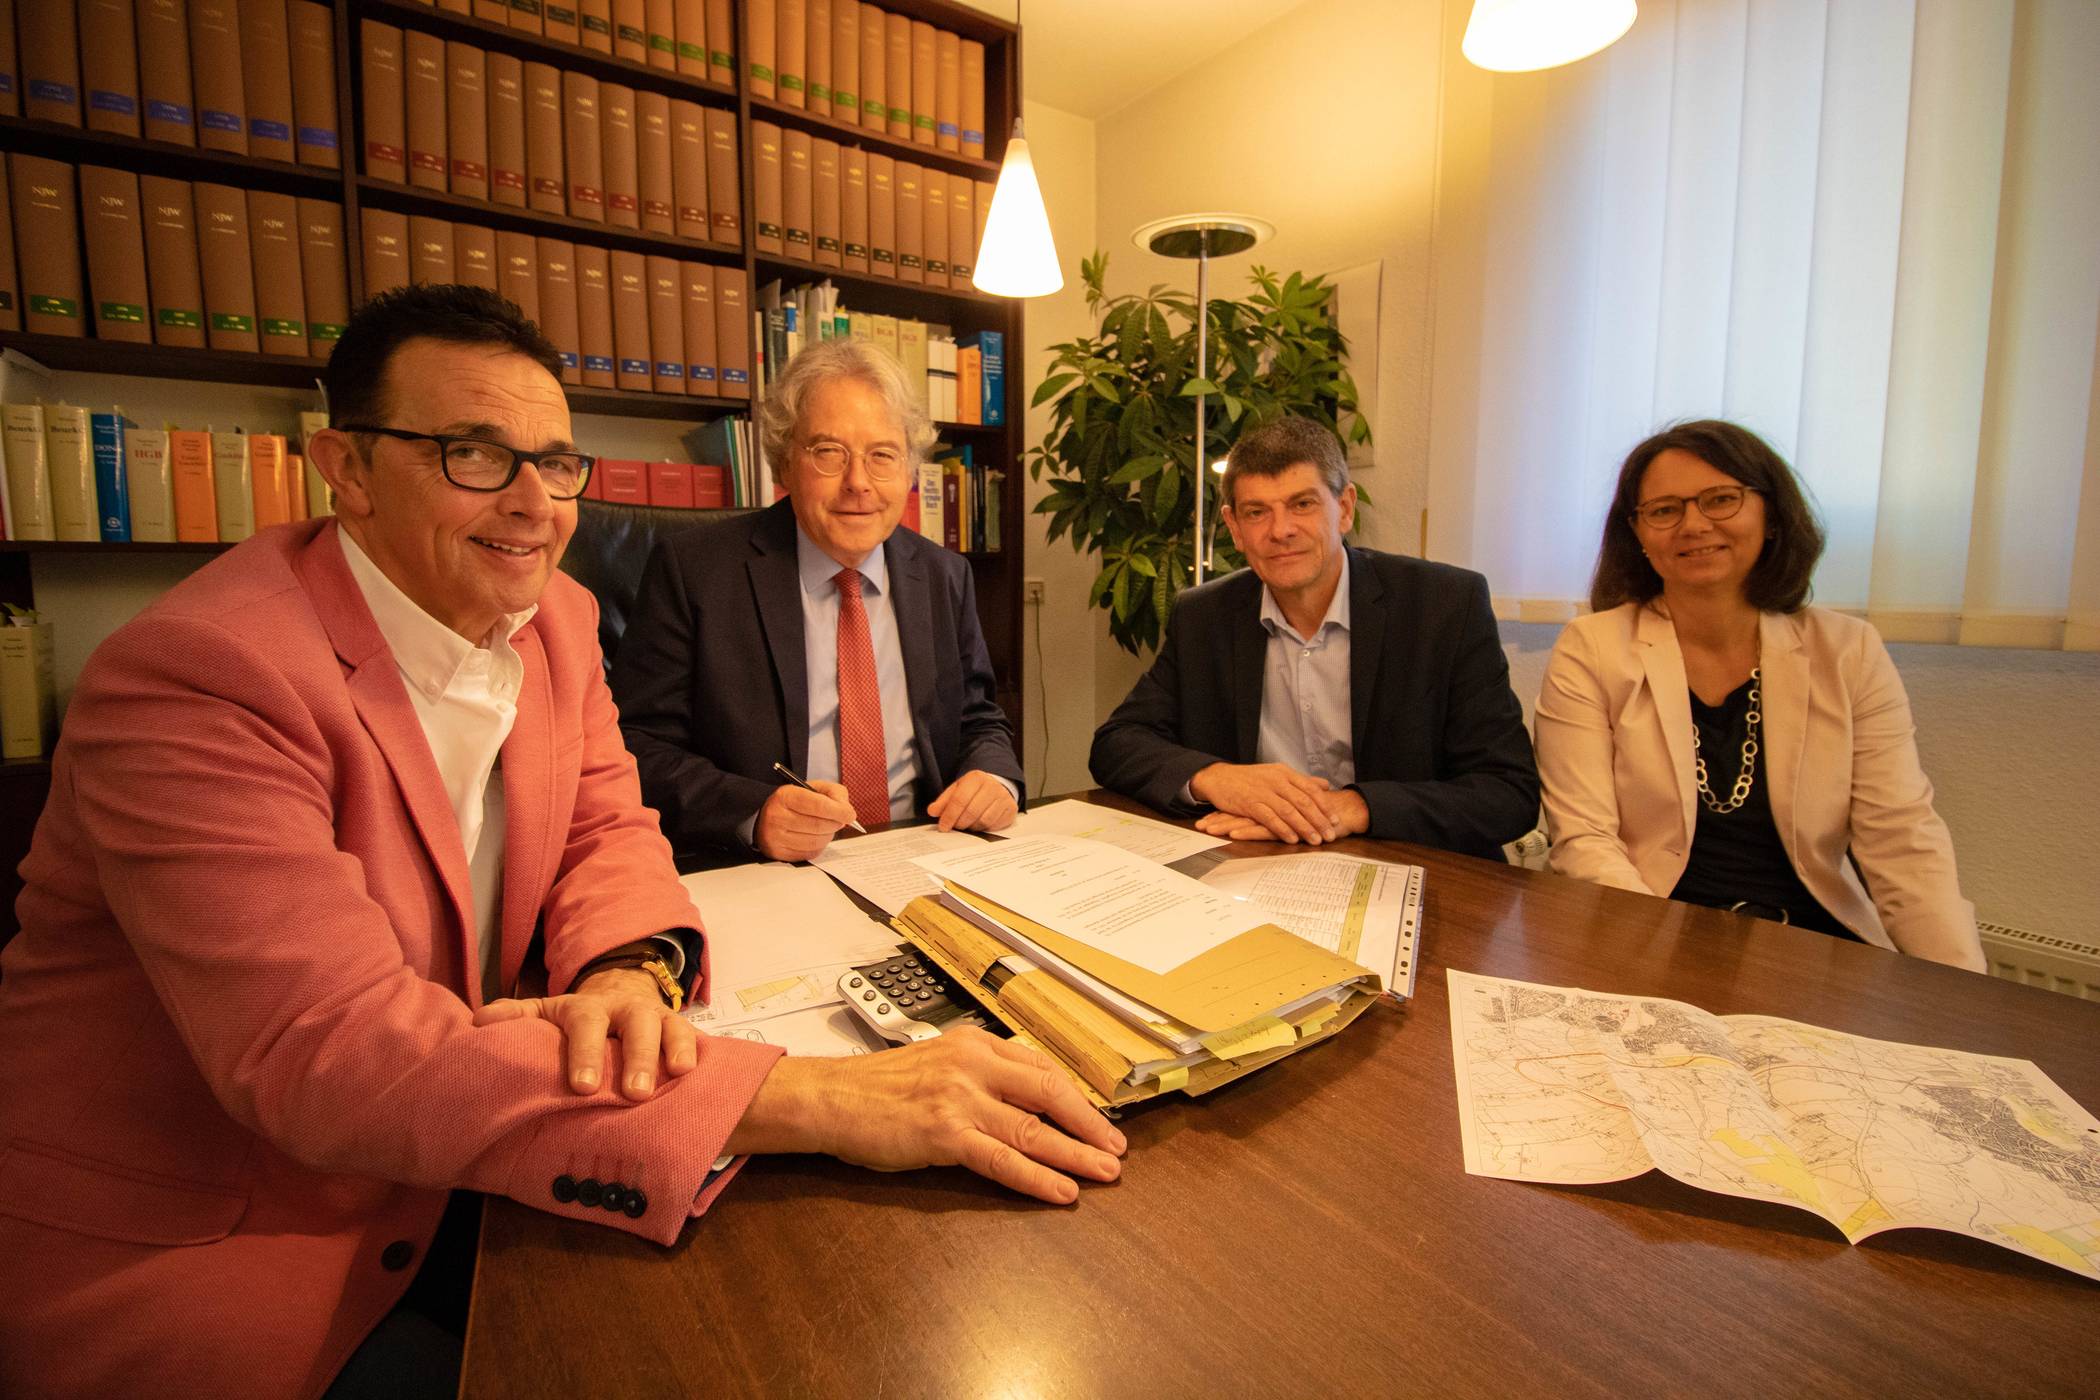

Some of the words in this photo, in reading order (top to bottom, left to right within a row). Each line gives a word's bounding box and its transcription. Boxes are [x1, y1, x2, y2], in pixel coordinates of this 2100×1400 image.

[100, 196, 124, 207] NJW
[158, 206, 182, 217] NJW
[211, 212, 234, 223] NJW
